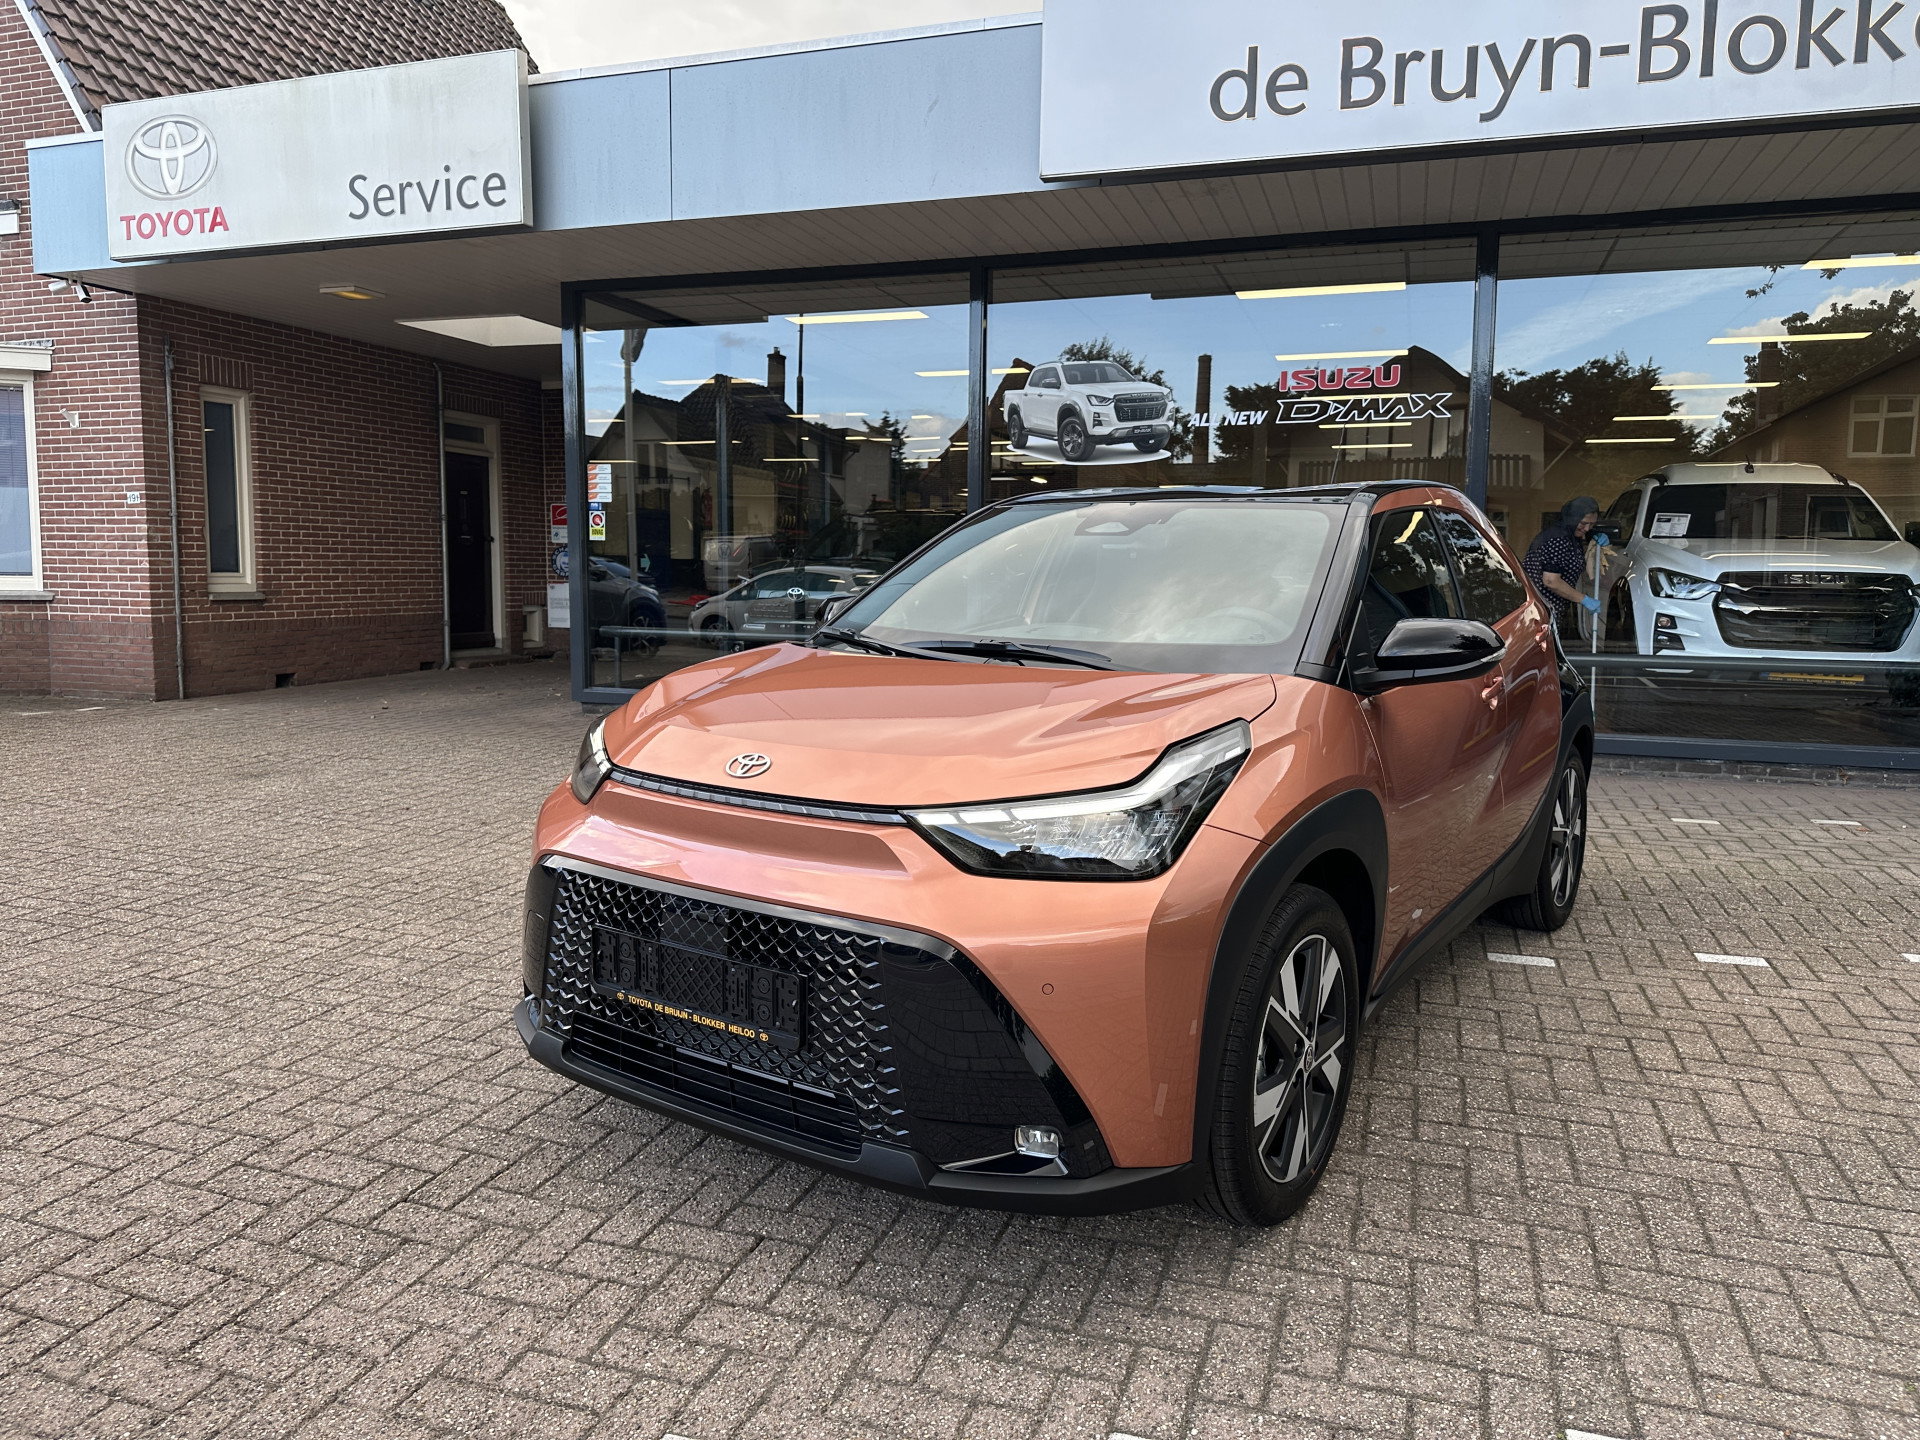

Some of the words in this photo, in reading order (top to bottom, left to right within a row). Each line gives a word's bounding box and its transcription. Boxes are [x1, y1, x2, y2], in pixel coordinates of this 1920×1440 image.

[1209, 45, 1309, 122] de
[1340, 0, 1920, 123] Bruyn-Blokk
[347, 164, 508, 221] Service
[119, 205, 230, 242] TOYOTA
[1278, 364, 1401, 393] ISUZU
[1187, 412, 1221, 428] ALL
[1223, 410, 1269, 426] NEW
[1783, 574, 1850, 585] ISUZU
[627, 995, 652, 1009] TOYOTA
[654, 1003, 663, 1014] DE
[664, 1006, 688, 1020] BRUIJN
[693, 1015, 726, 1031] BLOKKER
[728, 1023, 756, 1039] HEILOO
